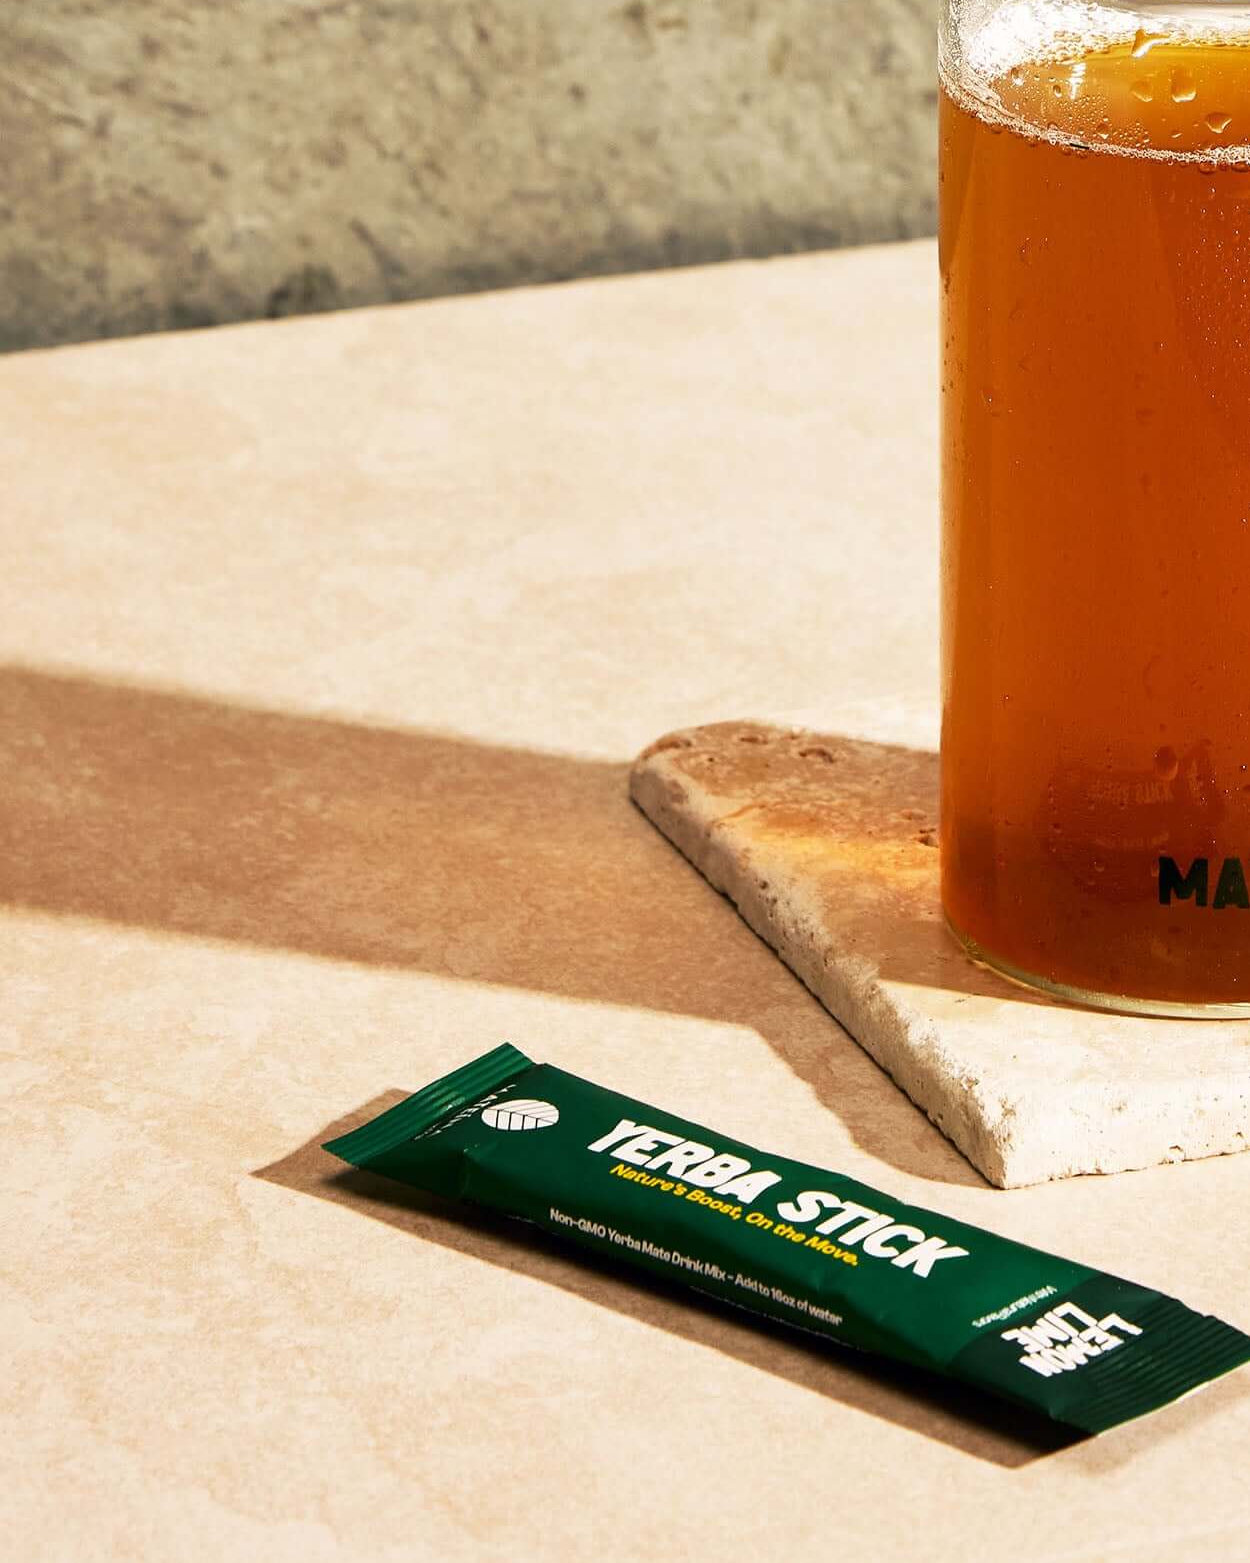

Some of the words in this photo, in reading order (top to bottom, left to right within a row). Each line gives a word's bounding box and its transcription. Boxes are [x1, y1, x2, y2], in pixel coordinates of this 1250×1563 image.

[587, 1119, 782, 1204] YERBA
[776, 1190, 970, 1278] STICK
[609, 1163, 688, 1196] Nature's
[685, 1189, 743, 1220] Boost,
[745, 1212, 774, 1230] On
[773, 1223, 806, 1243] the
[804, 1236, 858, 1266] Move.
[550, 1207, 606, 1238] Non-GMO
[607, 1227, 641, 1251] Yerba
[641, 1239, 670, 1261] Mate
[671, 1251, 704, 1275] Drink
[704, 1263, 727, 1282] Mix
[734, 1273, 758, 1293] Add
[759, 1283, 770, 1297] to
[770, 1287, 796, 1308] 16oz
[796, 1299, 808, 1312] of
[808, 1304, 843, 1326] water
[1000, 1301, 1098, 1355] LIME
[1018, 1312, 1144, 1378] LEMON
